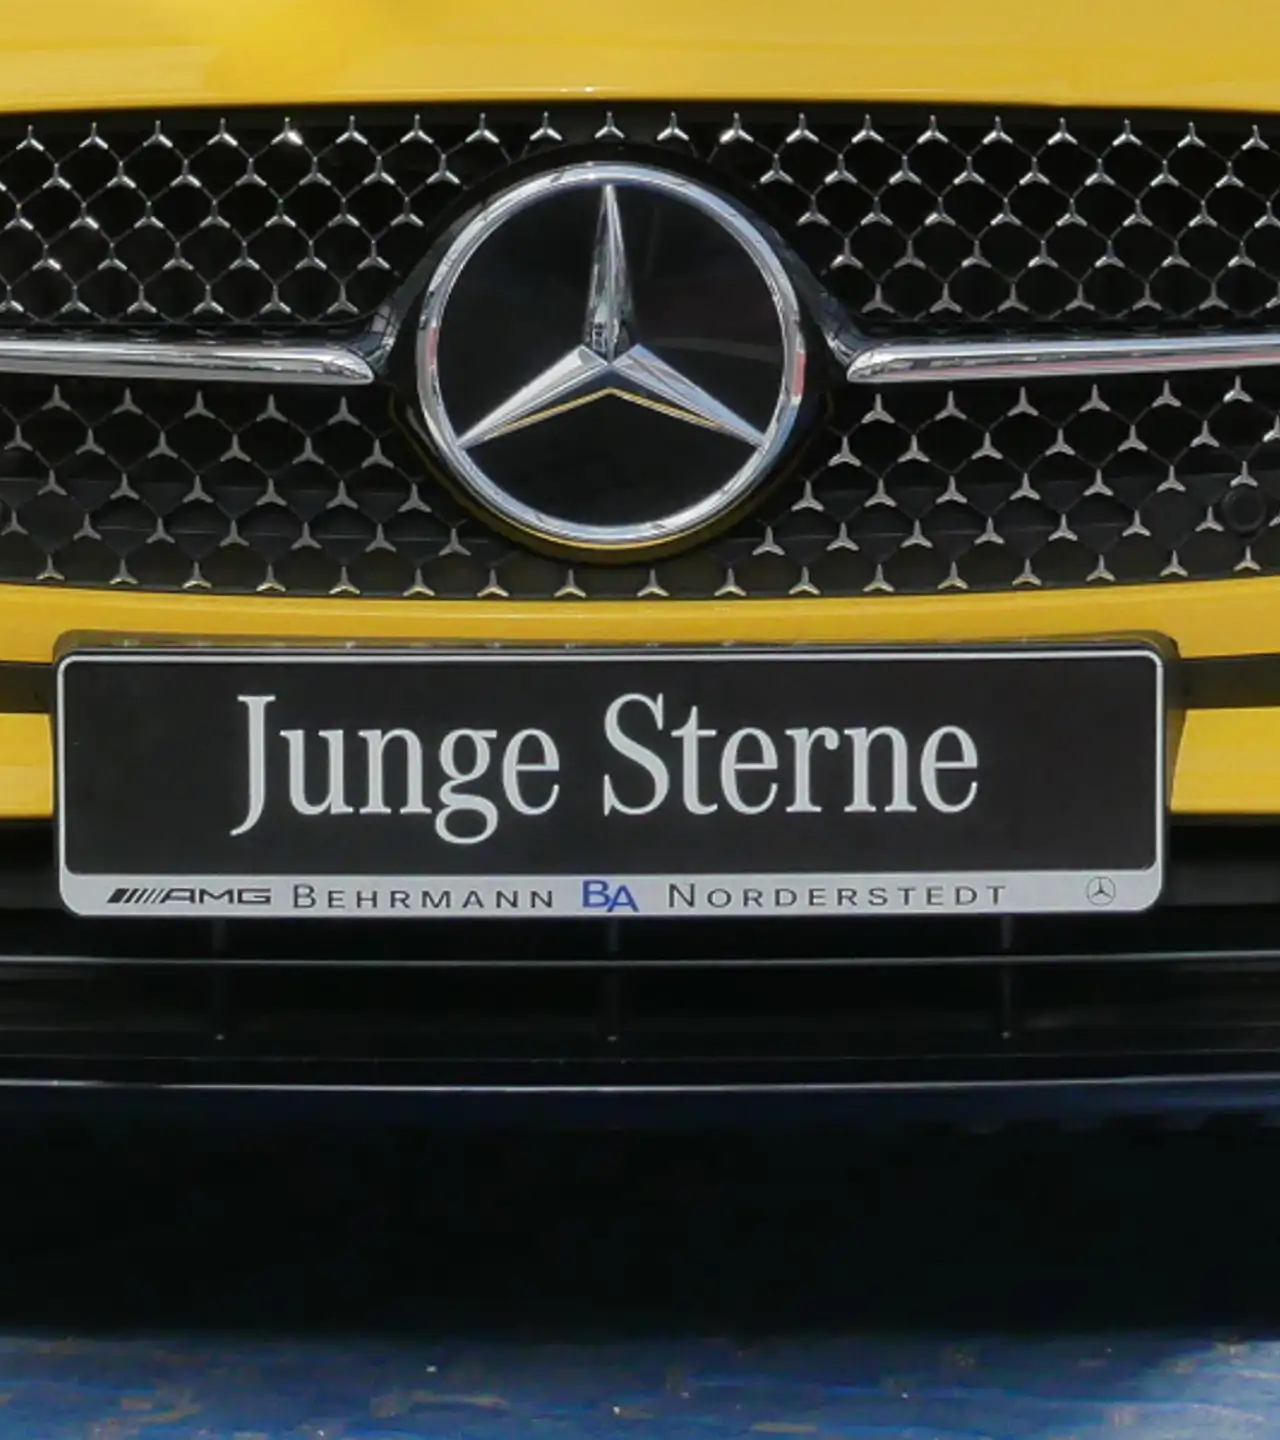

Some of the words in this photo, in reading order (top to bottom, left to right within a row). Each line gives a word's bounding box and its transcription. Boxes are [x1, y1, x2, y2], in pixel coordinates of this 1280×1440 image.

[230, 695, 560, 845] Junge
[603, 693, 978, 816] Sterne
[292, 883, 554, 910] BEHRMANN
[581, 878, 640, 914] BA
[668, 882, 1006, 909] NORDERSTEDT
